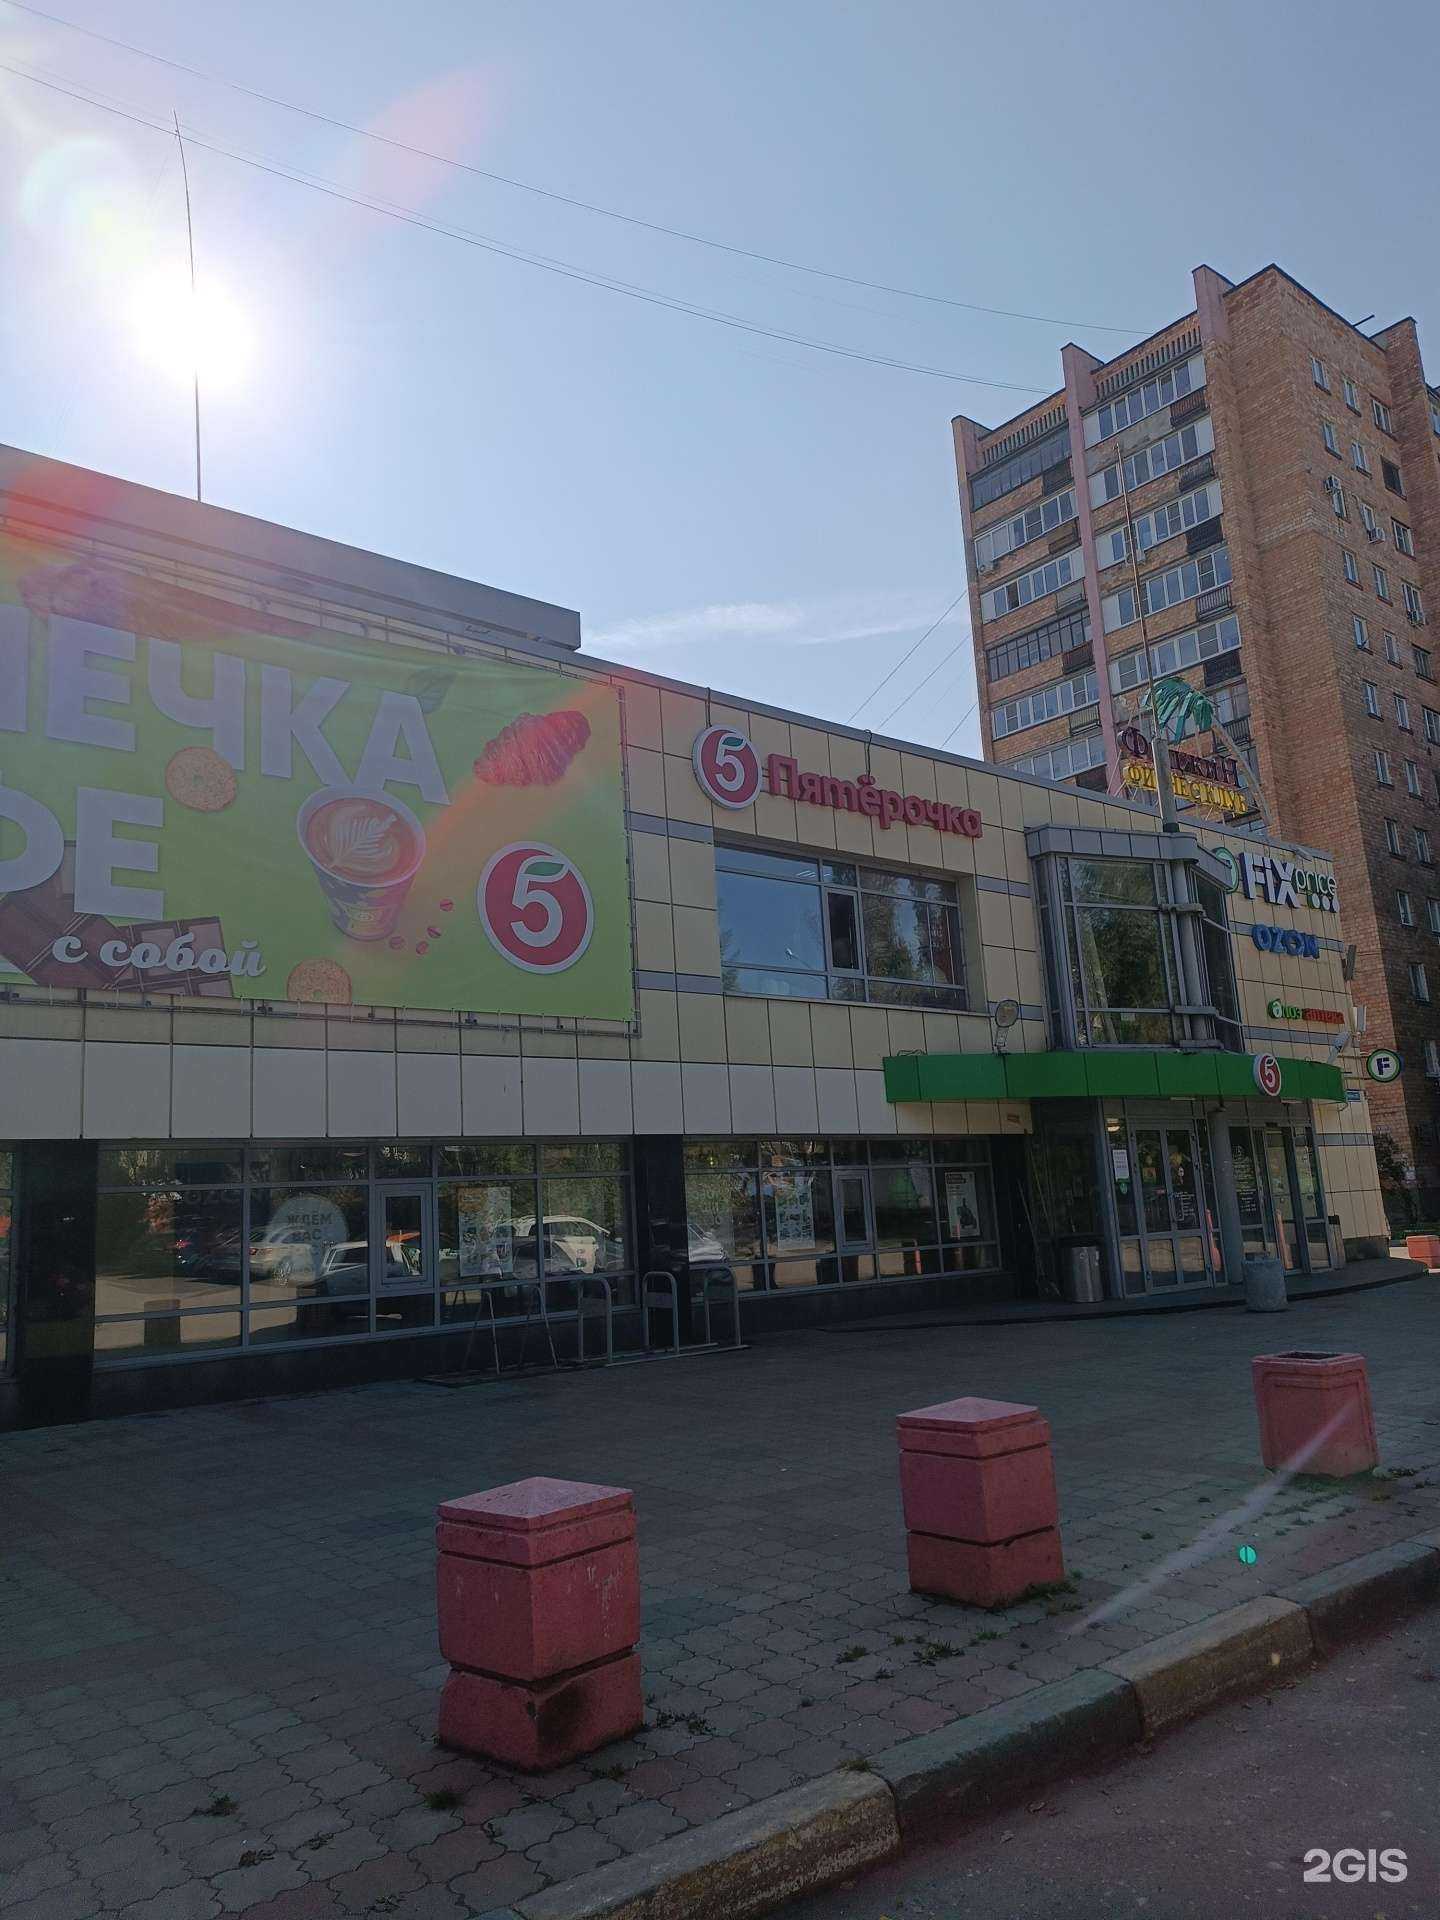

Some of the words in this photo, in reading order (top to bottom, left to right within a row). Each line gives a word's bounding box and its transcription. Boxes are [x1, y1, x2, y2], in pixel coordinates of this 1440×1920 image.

[767, 753, 983, 839] Пятёрочка
[1296, 869, 1338, 896] price
[52, 935, 88, 963] с
[100, 932, 267, 976] собой
[1252, 924, 1320, 959] OZON
